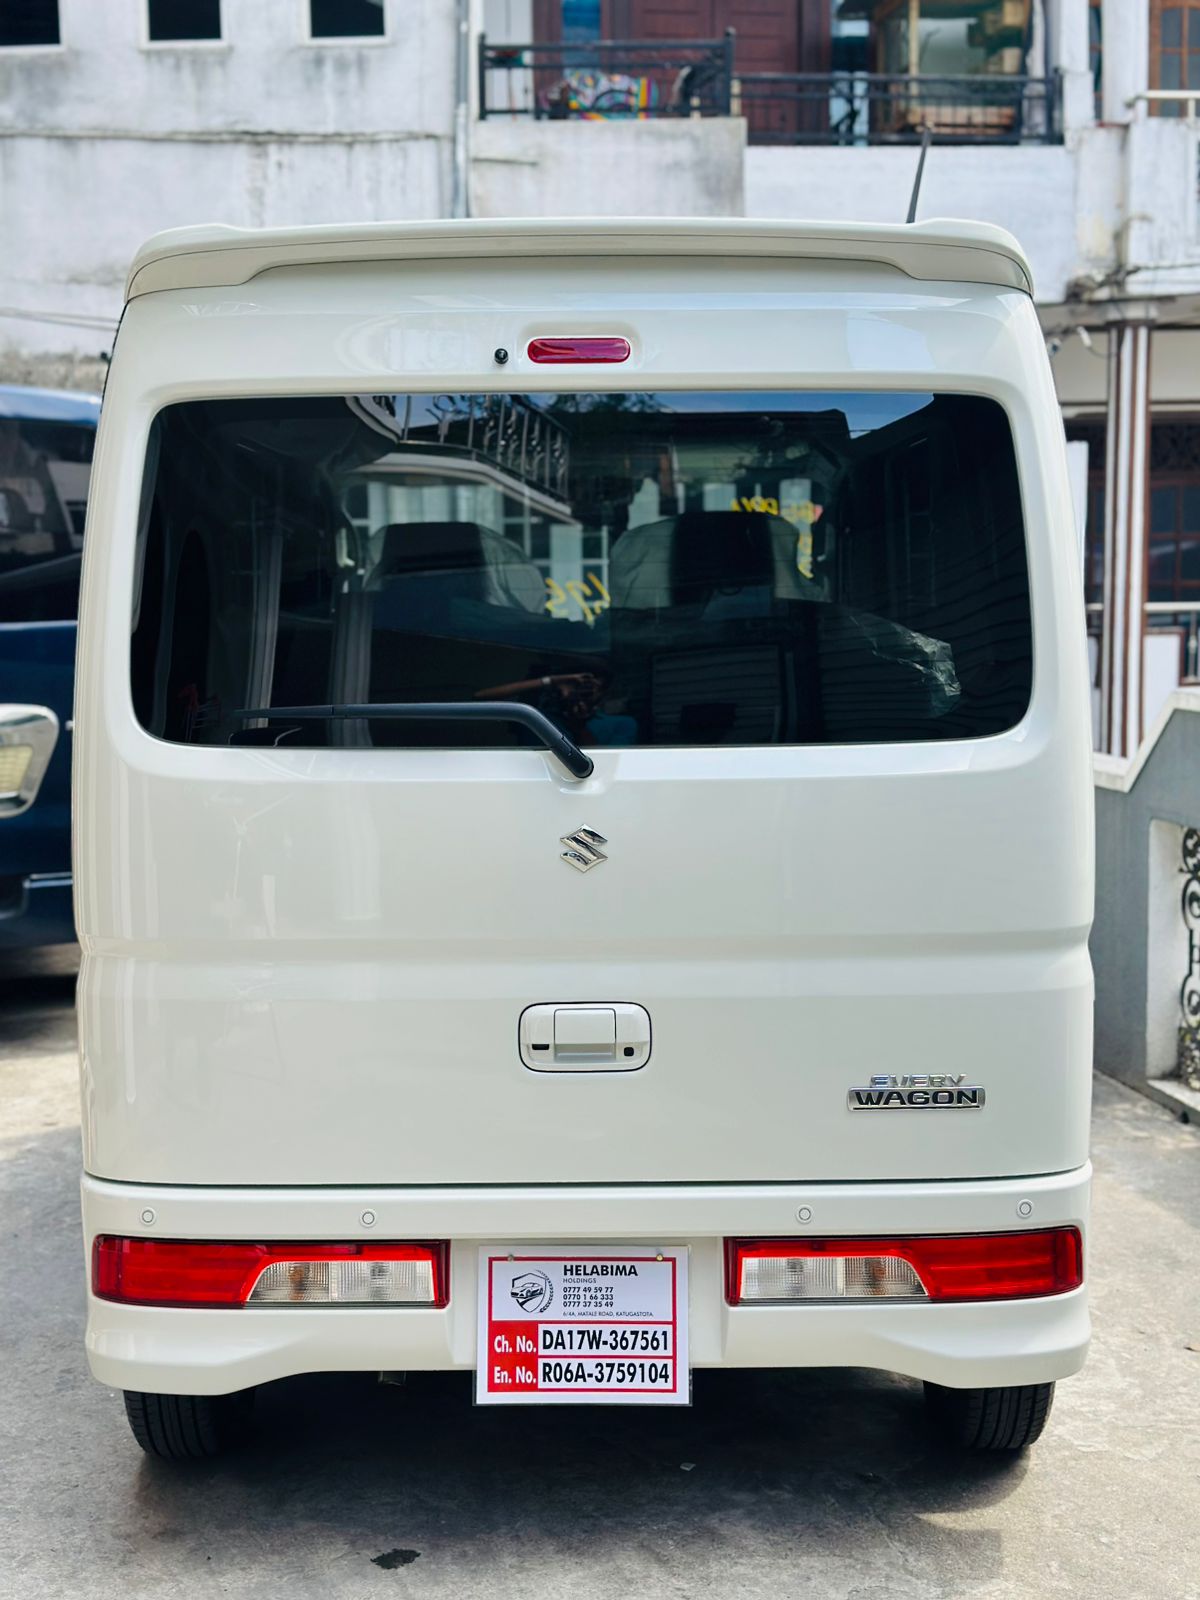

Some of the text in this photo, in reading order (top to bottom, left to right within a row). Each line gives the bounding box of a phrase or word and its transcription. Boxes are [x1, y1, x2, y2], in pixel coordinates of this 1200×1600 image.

[870, 1073, 967, 1088] EVERY
[855, 1089, 978, 1105] WAGON
[563, 1264, 638, 1276] HELABIMA
[494, 1336, 536, 1353] Ch. No.
[542, 1330, 668, 1351] DA17W-367561
[494, 1366, 536, 1384] En. No.
[542, 1362, 669, 1383] R06A-3759104
